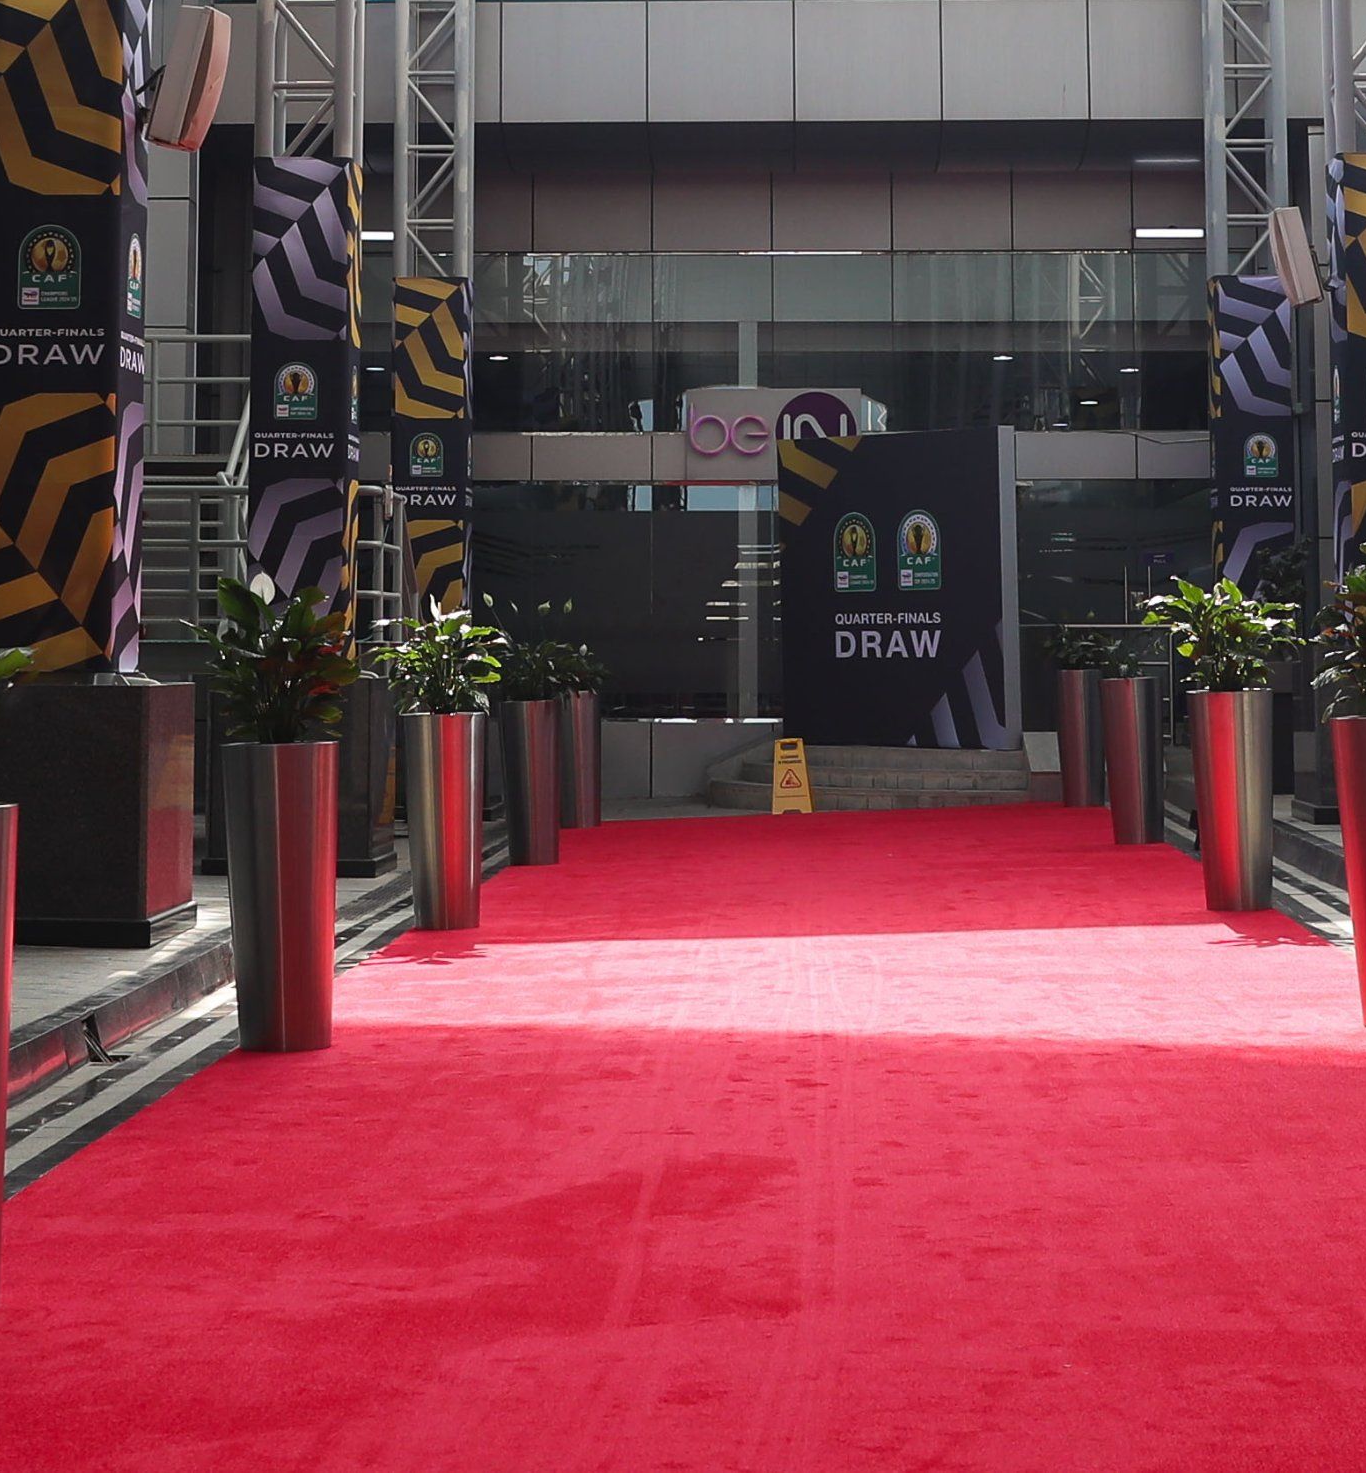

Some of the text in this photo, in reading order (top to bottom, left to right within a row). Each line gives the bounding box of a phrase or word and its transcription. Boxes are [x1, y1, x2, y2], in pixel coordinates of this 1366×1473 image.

[32, 274, 67, 283] CAF
[119, 345, 145, 375] DRAW
[254, 443, 335, 458] DRAW
[1230, 495, 1292, 507] DRAW
[843, 559, 867, 567] CAF
[907, 556, 932, 565] CAF
[835, 612, 941, 625] QUARTER-FINALS
[835, 630, 942, 659] DRAW
